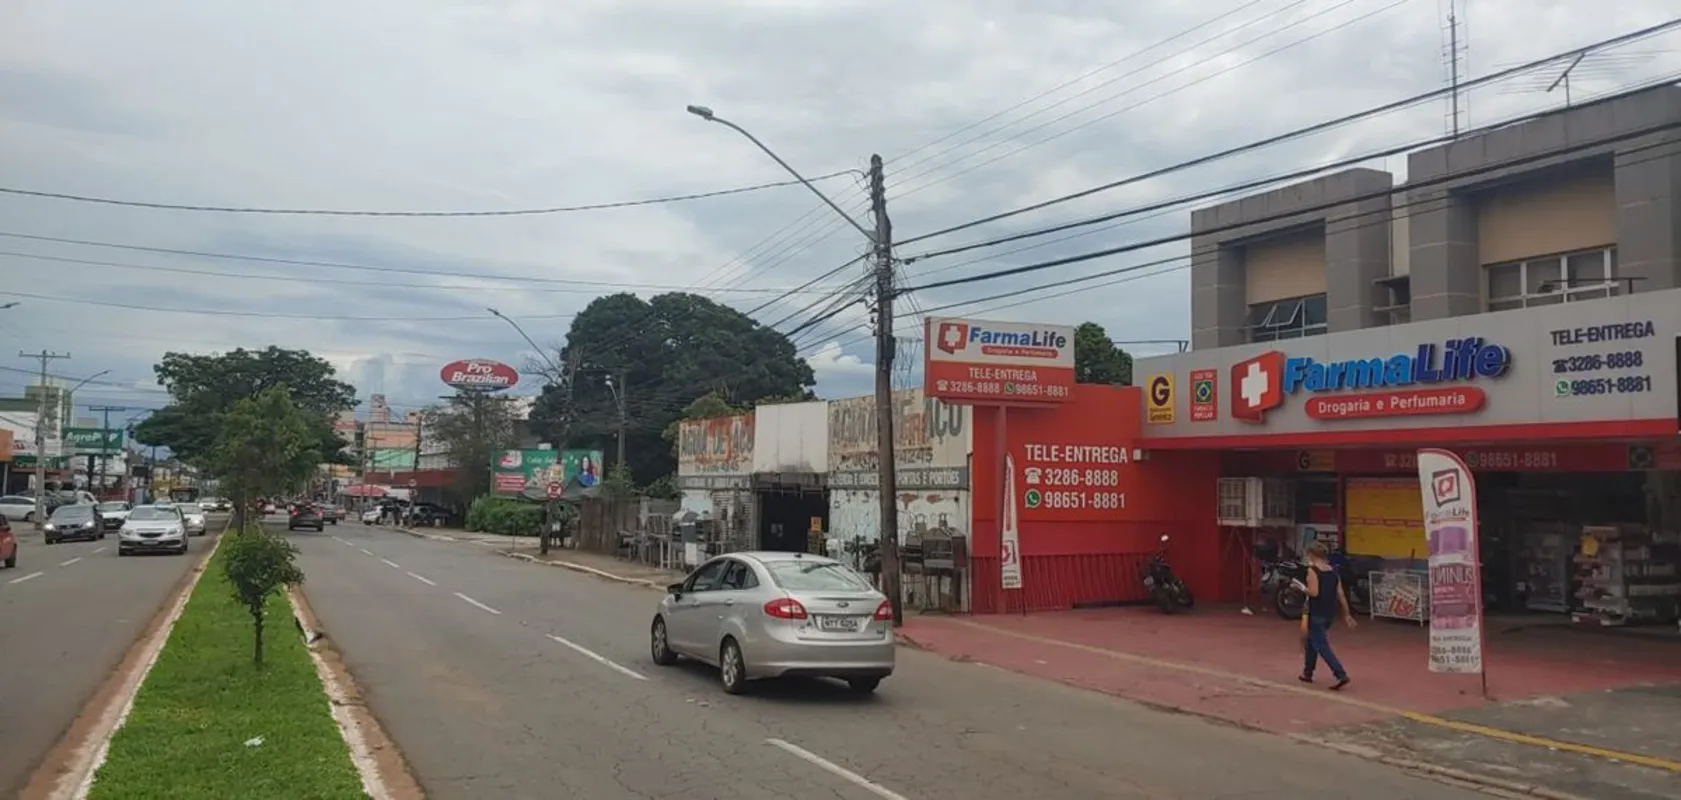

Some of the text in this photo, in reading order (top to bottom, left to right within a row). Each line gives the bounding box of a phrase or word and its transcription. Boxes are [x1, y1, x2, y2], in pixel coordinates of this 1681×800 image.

[969, 327, 1066, 348] FarmaLife
[1550, 321, 1655, 345] TELE-ENTREGA
[467, 363, 492, 374] Pro
[1282, 337, 1513, 392] FarmaLife
[1569, 351, 1644, 372] 3286-8888
[452, 371, 509, 384] Brazilian
[969, 367, 1037, 380] TELE-ENTREGA
[950, 381, 1068, 397] 3286-8888 98651-8881
[1151, 376, 1170, 406] G
[1571, 376, 1652, 396] 98651-8881
[1318, 392, 1467, 414] Drogaria e Perfumaria
[1025, 444, 1128, 463] TELE-ENTREGA
[1480, 452, 1557, 467] 98651-8881
[1045, 468, 1118, 486] 3286-8888
[1045, 491, 1126, 509] 98651-8881
